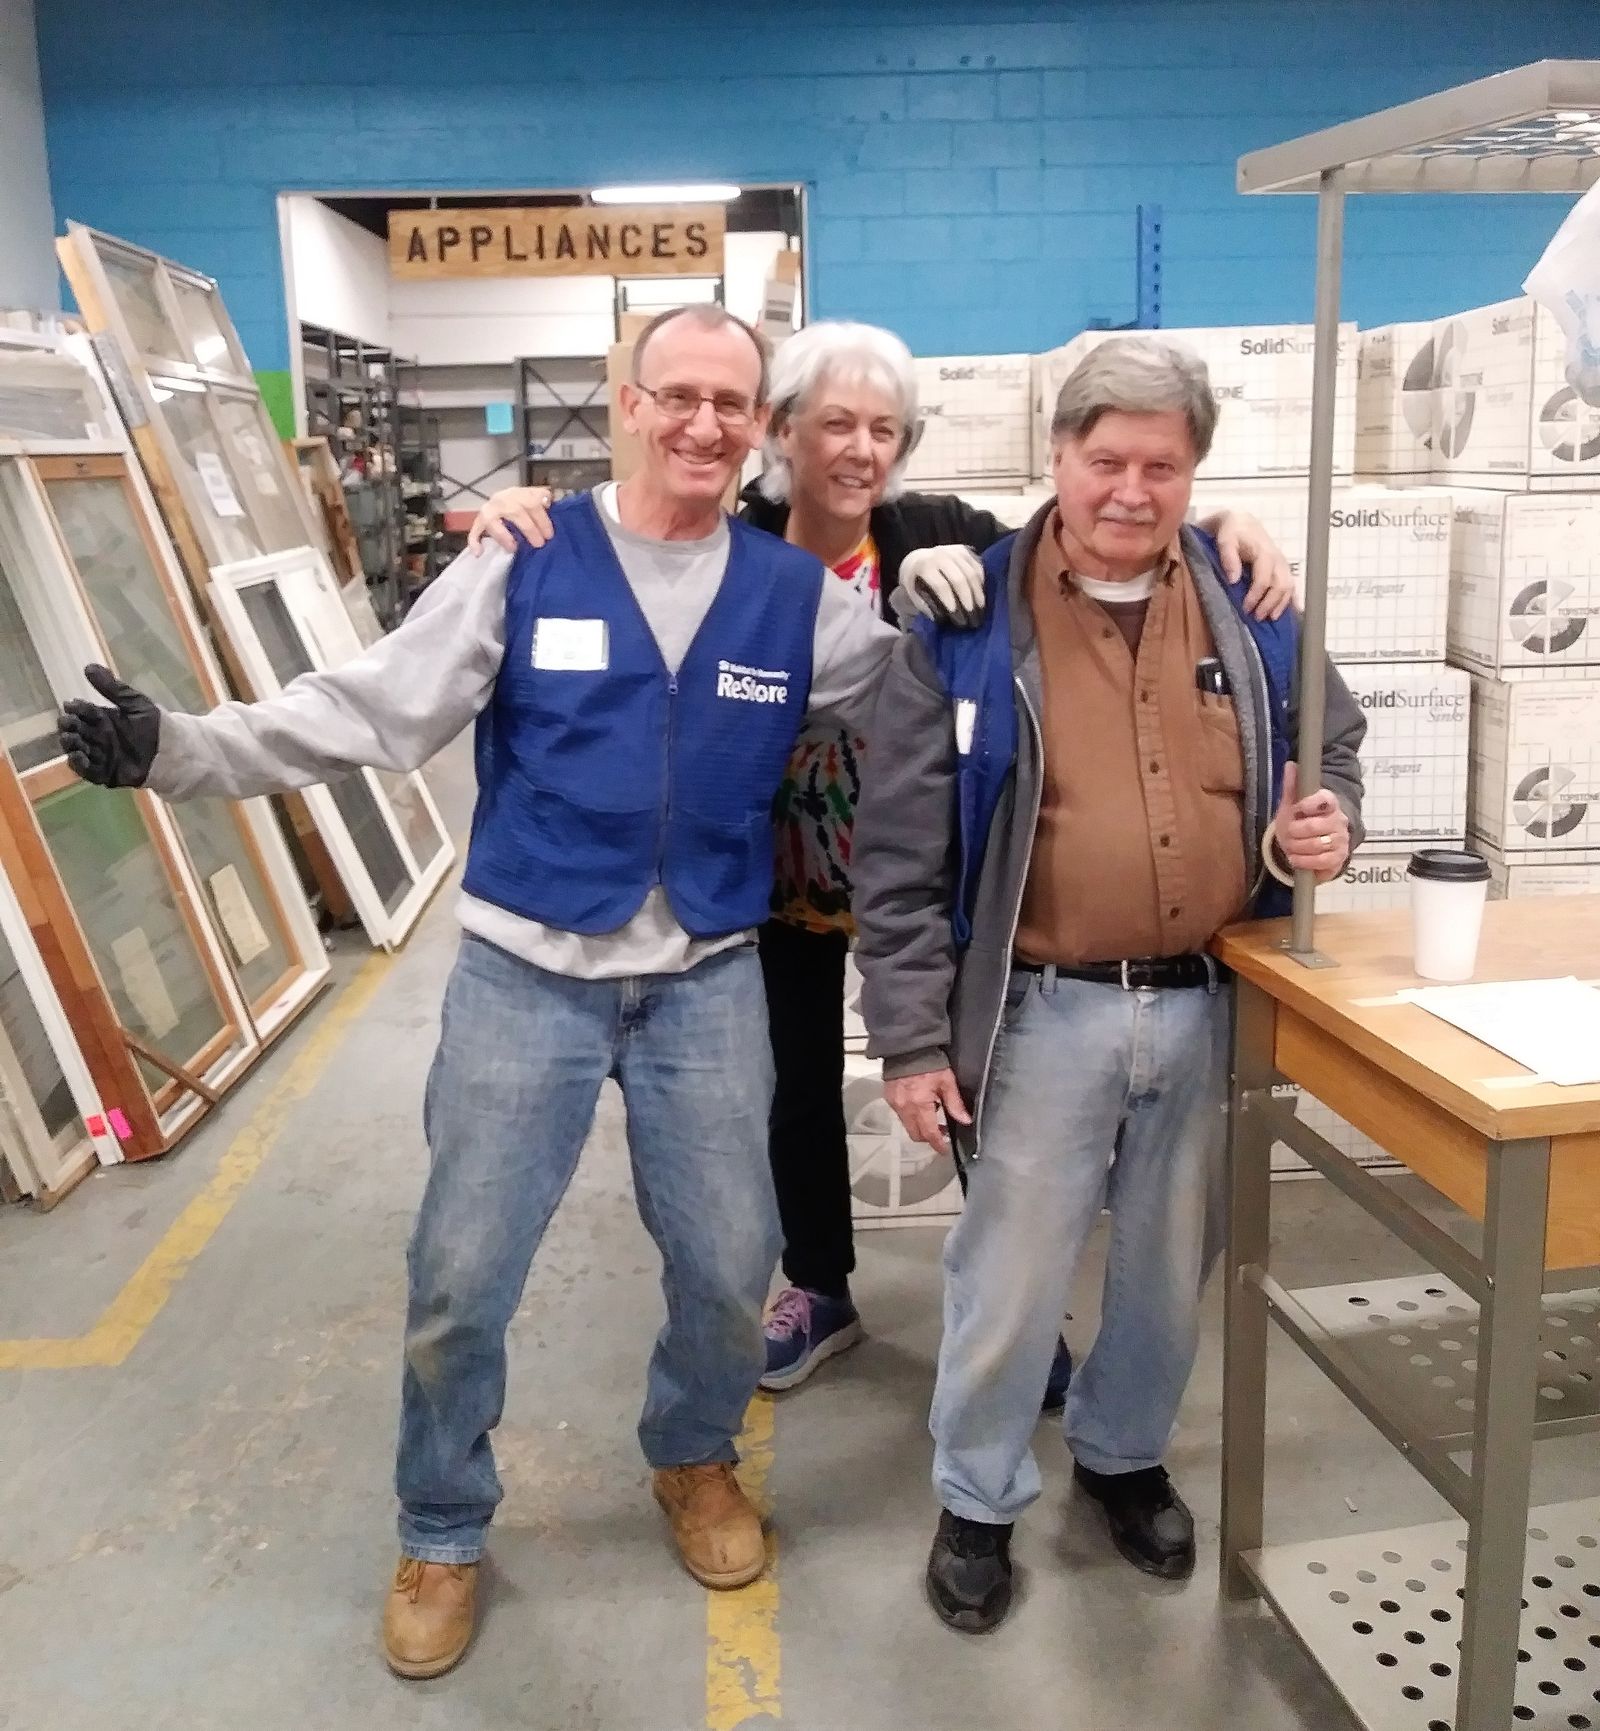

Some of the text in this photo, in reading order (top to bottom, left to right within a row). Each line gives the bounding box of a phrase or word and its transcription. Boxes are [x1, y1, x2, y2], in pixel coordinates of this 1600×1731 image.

[407, 223, 708, 262] APPLIANCES
[1331, 506, 1448, 528] SolidSurface
[717, 672, 788, 704] ReStore
[1374, 759, 1422, 779] Elegant
